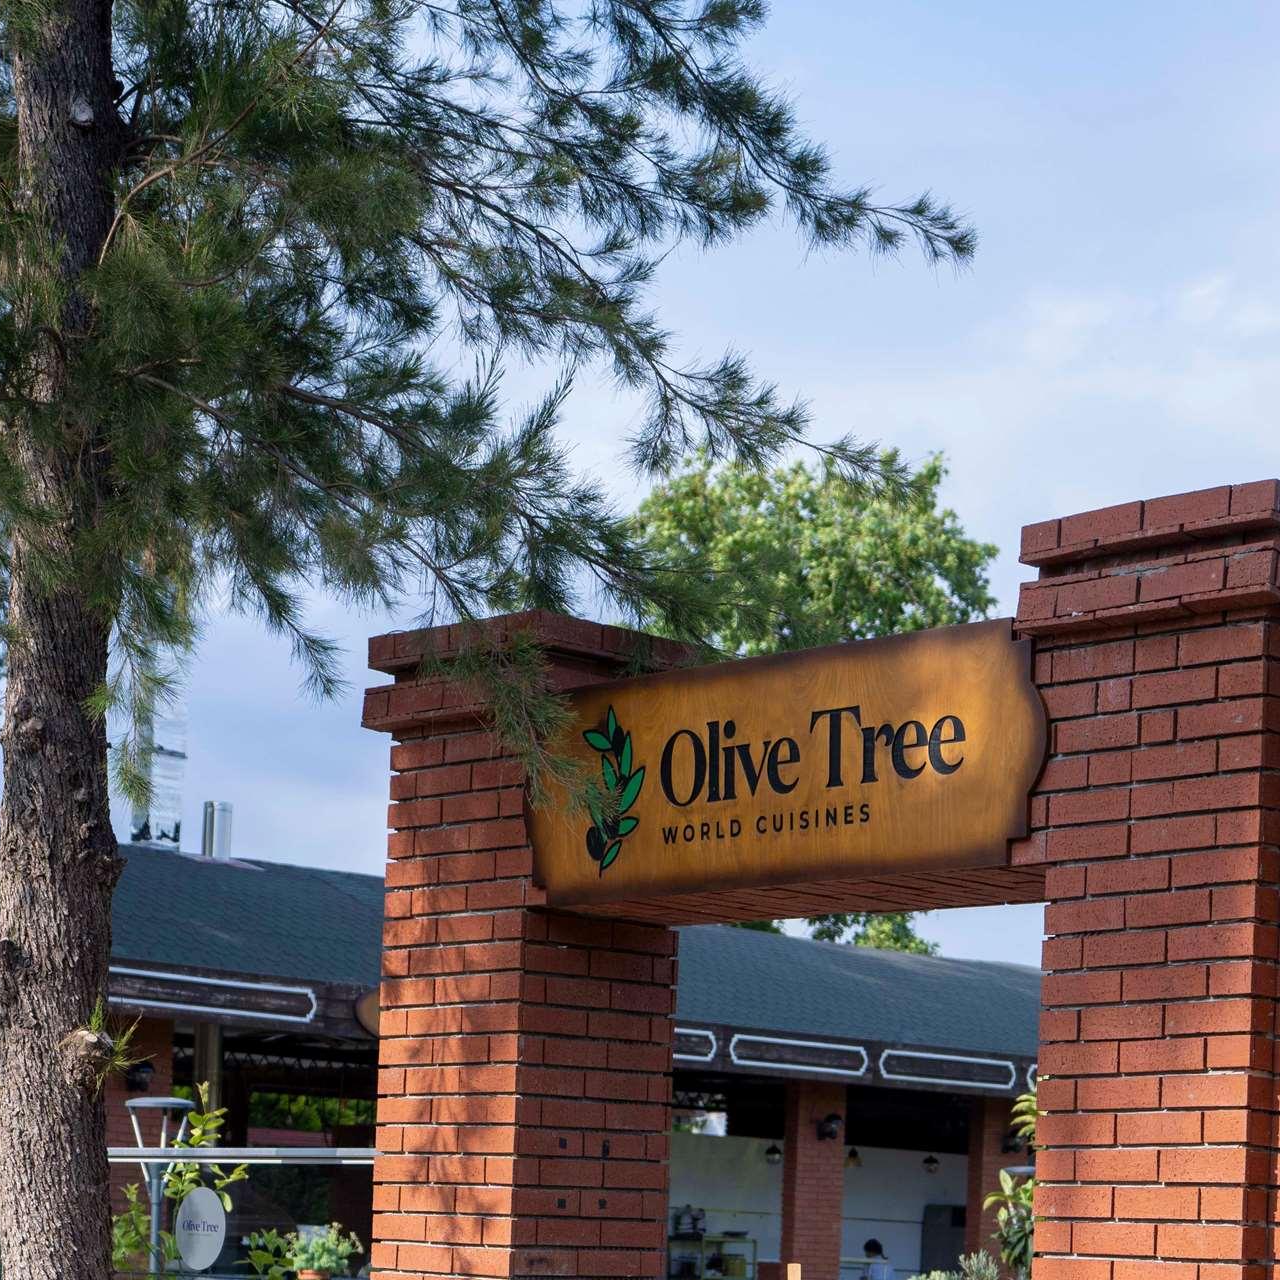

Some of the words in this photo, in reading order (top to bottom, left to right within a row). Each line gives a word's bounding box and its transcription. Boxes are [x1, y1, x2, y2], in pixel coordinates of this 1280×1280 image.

[660, 719, 801, 808] Olive
[809, 704, 967, 788] Tree
[661, 819, 742, 846] WORLD
[756, 803, 873, 835] CUISINES
[182, 1220, 200, 1232] Olive
[200, 1220, 219, 1233] Tree
